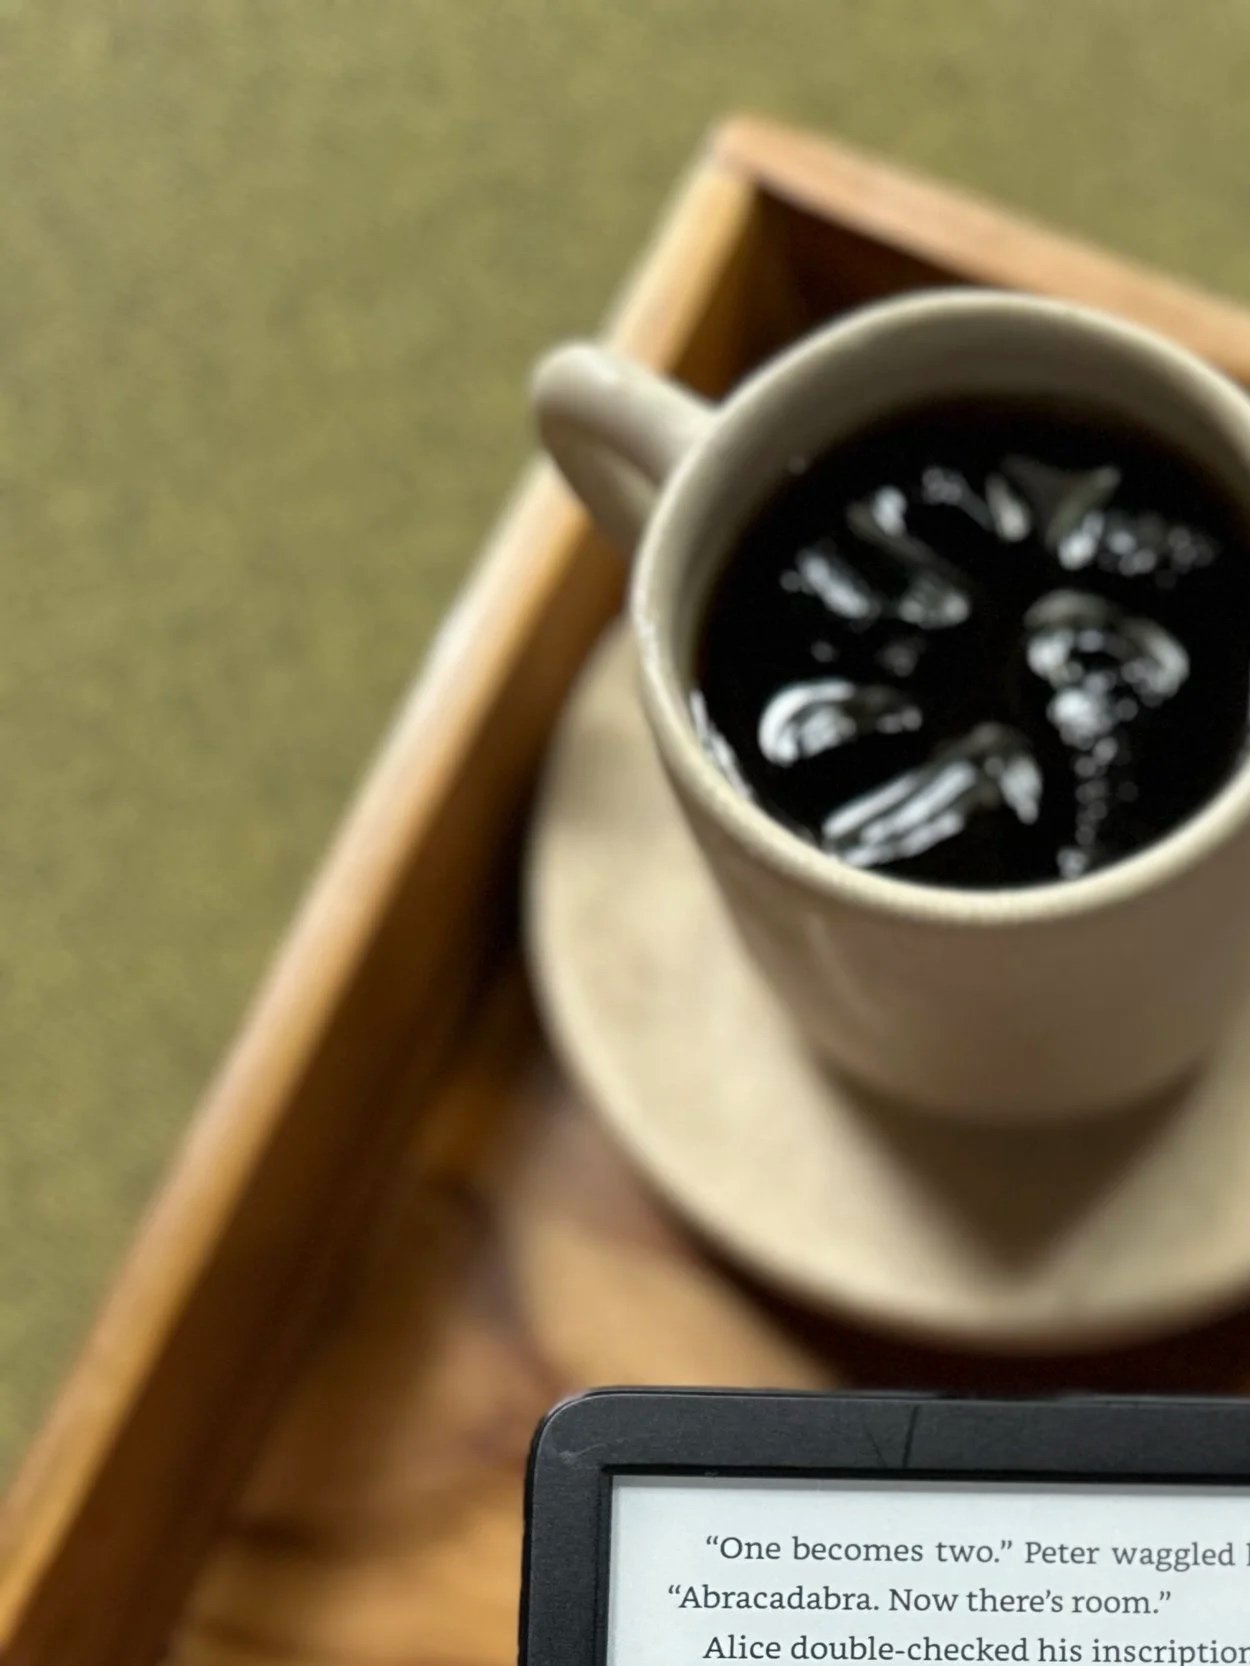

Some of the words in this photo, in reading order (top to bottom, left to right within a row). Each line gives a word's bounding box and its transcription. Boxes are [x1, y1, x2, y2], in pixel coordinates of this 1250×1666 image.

[705, 1535, 782, 1561] “One
[791, 1535, 924, 1563] becomes
[935, 1539, 1013, 1564] two.”
[1024, 1541, 1101, 1565] Peter
[1111, 1541, 1236, 1573] waggled
[667, 1583, 880, 1612] “Abracadabra.
[888, 1587, 960, 1613] Now
[965, 1586, 1064, 1614] there’s
[1071, 1590, 1172, 1615] room.”
[701, 1633, 782, 1660] Alice
[790, 1634, 1030, 1663] double-checked
[1037, 1636, 1083, 1663] his
